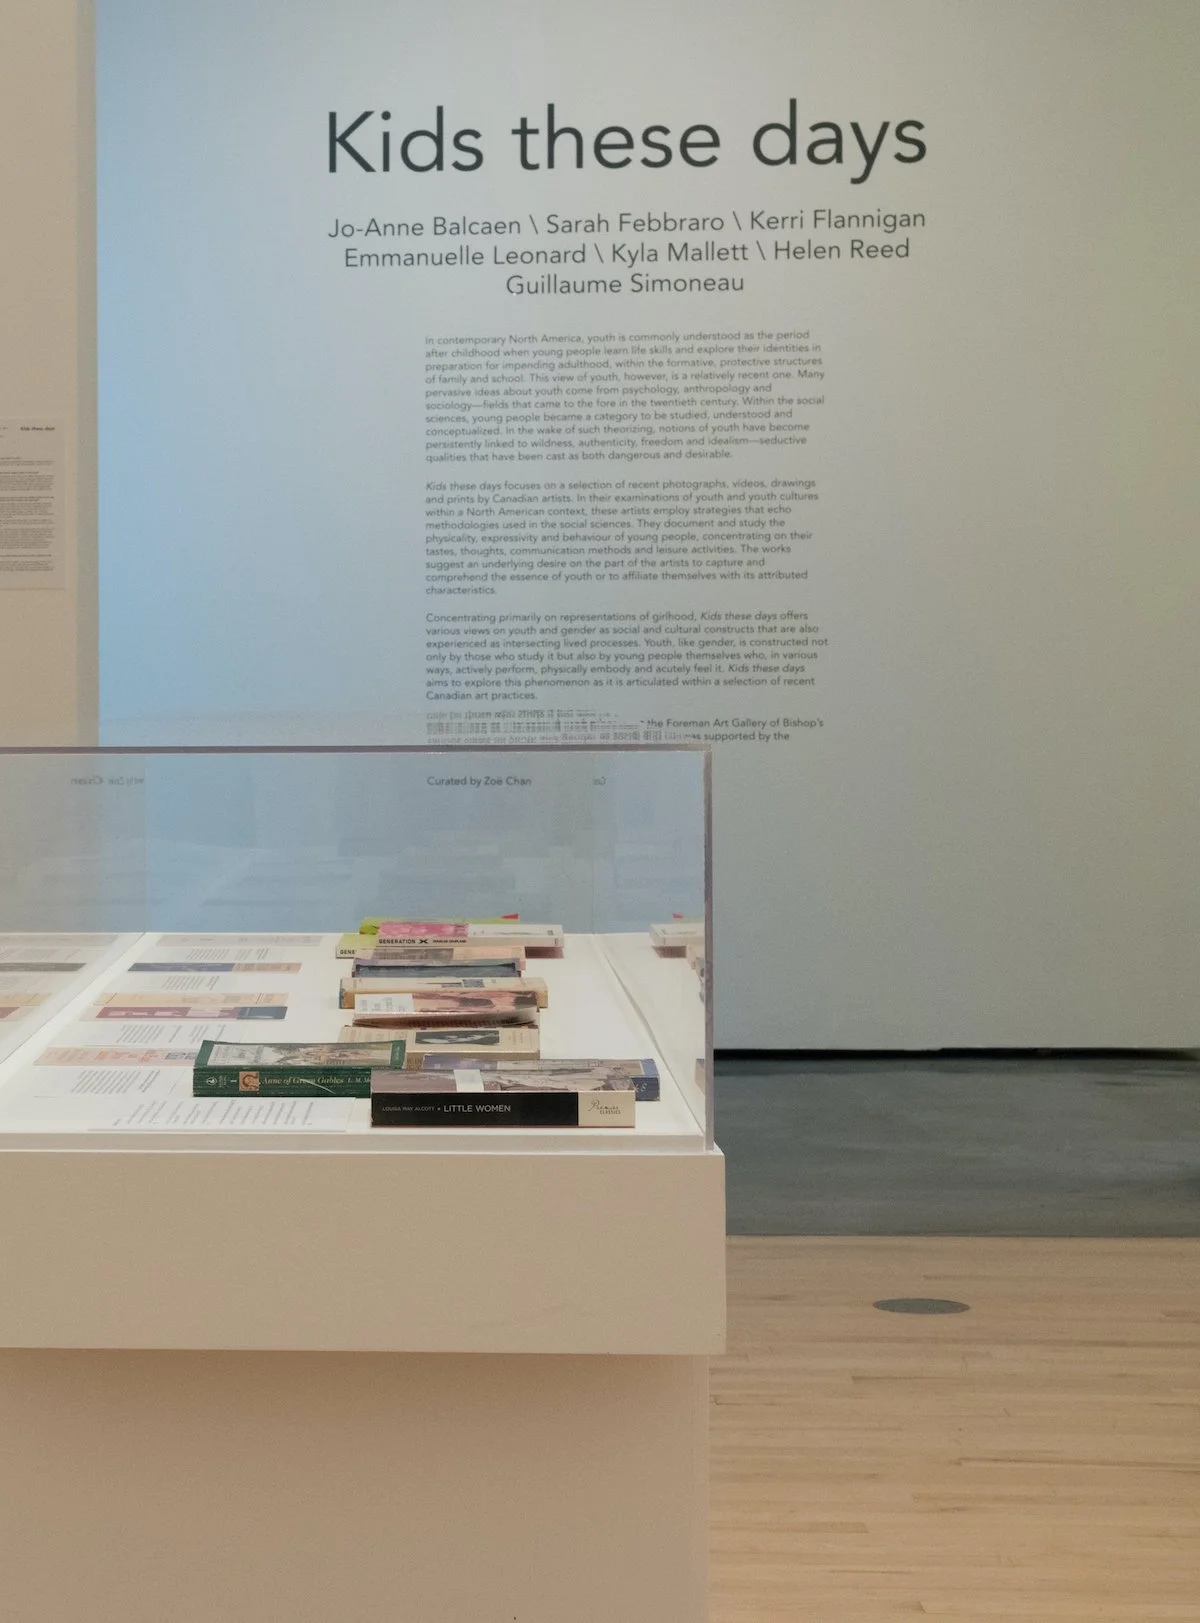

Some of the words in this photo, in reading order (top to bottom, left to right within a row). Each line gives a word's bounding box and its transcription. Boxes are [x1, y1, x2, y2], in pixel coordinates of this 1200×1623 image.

[329, 105, 484, 173] Kids
[511, 103, 720, 171] these
[753, 98, 927, 185] days
[328, 218, 424, 238] Jo-Anne
[434, 216, 520, 235] Balcaen
[547, 213, 609, 234] Sarah
[619, 212, 724, 232] Febbraro
[751, 210, 803, 230] Kerri
[814, 209, 925, 234] Flannigan
[345, 245, 484, 267] Emmanuelle
[494, 244, 585, 264] Leonard
[613, 242, 658, 268] Kyla
[668, 241, 748, 261] Mallett
[775, 239, 840, 260] Helen
[851, 238, 909, 258] Reed
[506, 274, 621, 295] Guillaume
[631, 273, 743, 293] Simoneau
[425, 336, 434, 345] In
[437, 336, 506, 348] contemporary
[509, 334, 538, 344] North
[587, 333, 615, 345] youth
[618, 334, 626, 342] is
[628, 332, 681, 345] commonly
[683, 331, 741, 341] understood
[757, 330, 774, 340] the
[776, 330, 810, 342] period
[425, 439, 482, 452] persistently
[484, 439, 514, 448] linked
[517, 440, 528, 448] to
[641, 437, 683, 446] freedom
[686, 436, 705, 446] and
[426, 482, 447, 491] Kids
[450, 481, 477, 491] these
[479, 481, 502, 493] days
[504, 481, 541, 490] focuses
[568, 480, 612, 490] selection
[615, 480, 625, 489] of
[628, 481, 660, 489] recent
[770, 478, 816, 490] drawings
[425, 613, 497, 626] Concentrating
[499, 613, 541, 625] primarily
[560, 613, 636, 624] representations
[639, 612, 650, 621] of
[700, 611, 722, 620] Kids
[724, 611, 752, 620] these
[754, 611, 777, 623] days
[779, 611, 808, 620] offers
[425, 627, 461, 636] various
[463, 627, 491, 635] views
[508, 626, 537, 638] youth
[539, 626, 558, 635] and
[560, 625, 596, 638] gender
[612, 625, 640, 634] social
[643, 625, 662, 634] and
[664, 624, 701, 634] cultural
[704, 625, 755, 634] constructs
[757, 624, 778, 633] that
[799, 624, 819, 633] also
[426, 639, 487, 652] experienced
[503, 640, 561, 651] intersecting
[563, 638, 587, 648] lived
[678, 638, 696, 647] like
[739, 638, 747, 647] is
[749, 637, 809, 646] constructed
[811, 638, 829, 646] not
[426, 652, 447, 664] only
[449, 652, 462, 664] by
[464, 652, 492, 661] those
[494, 652, 515, 661] who
[517, 652, 545, 664] study
[547, 652, 554, 660] it
[556, 651, 574, 660] but
[575, 651, 596, 660] also
[599, 651, 612, 663] by
[614, 654, 645, 663] young
[648, 651, 683, 663] people
[685, 651, 741, 660] themselves
[771, 652, 780, 660] in
[782, 651, 818, 660] various
[455, 665, 493, 677] actively
[541, 664, 588, 676] physically
[590, 664, 631, 676] embody
[634, 664, 653, 673] and
[656, 664, 691, 676] acutely
[693, 664, 712, 673] feel
[728, 664, 750, 673] Kids
[752, 664, 780, 673] these
[782, 664, 805, 676] days
[666, 719, 710, 727] Foreman
[713, 719, 728, 727] Art
[732, 718, 766, 730] Gallery
[769, 718, 780, 727] of
[704, 732, 756, 742] supported
[758, 732, 770, 742] by
[773, 732, 789, 740] the
[427, 776, 467, 786] Curated
[469, 776, 482, 788] by
[484, 776, 503, 786] Zoë
[506, 776, 531, 786] Chan
[283, 1077, 292, 1085] of
